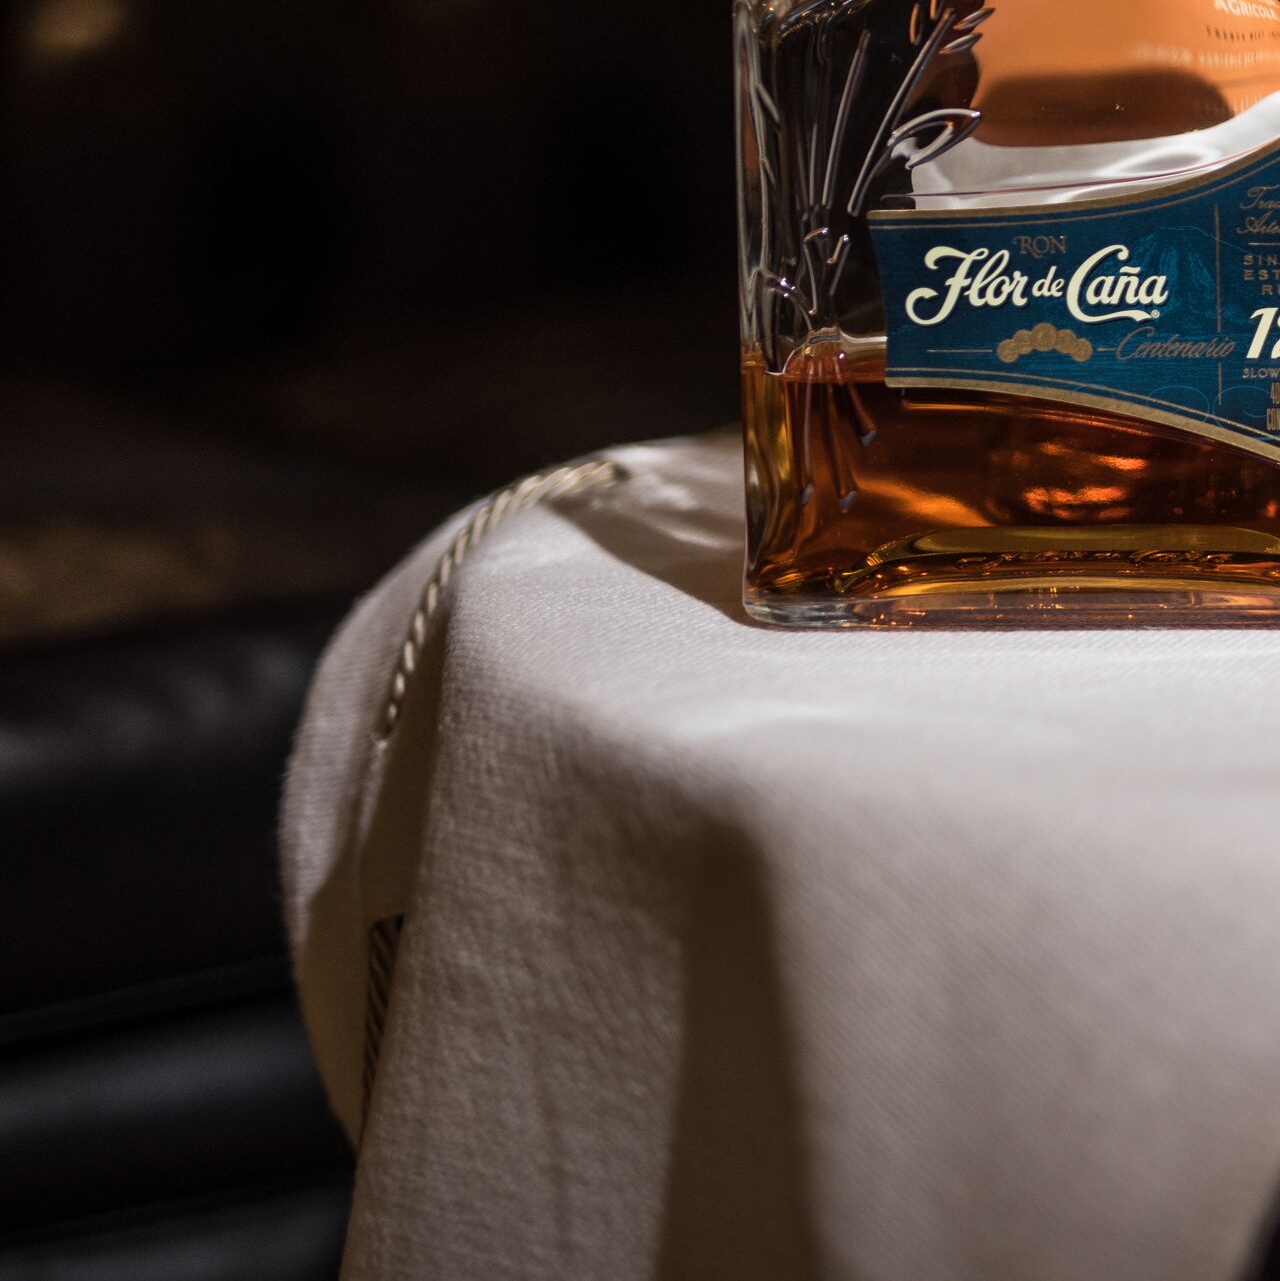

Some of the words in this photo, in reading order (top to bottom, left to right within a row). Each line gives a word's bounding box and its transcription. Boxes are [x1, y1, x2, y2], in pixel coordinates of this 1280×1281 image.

[1013, 235, 1067, 258] RON
[905, 245, 1028, 326] Flor
[1032, 266, 1065, 297] de
[1066, 244, 1169, 324] Caña
[1116, 326, 1237, 360] Centenario
[1242, 367, 1280, 379] SLOW
